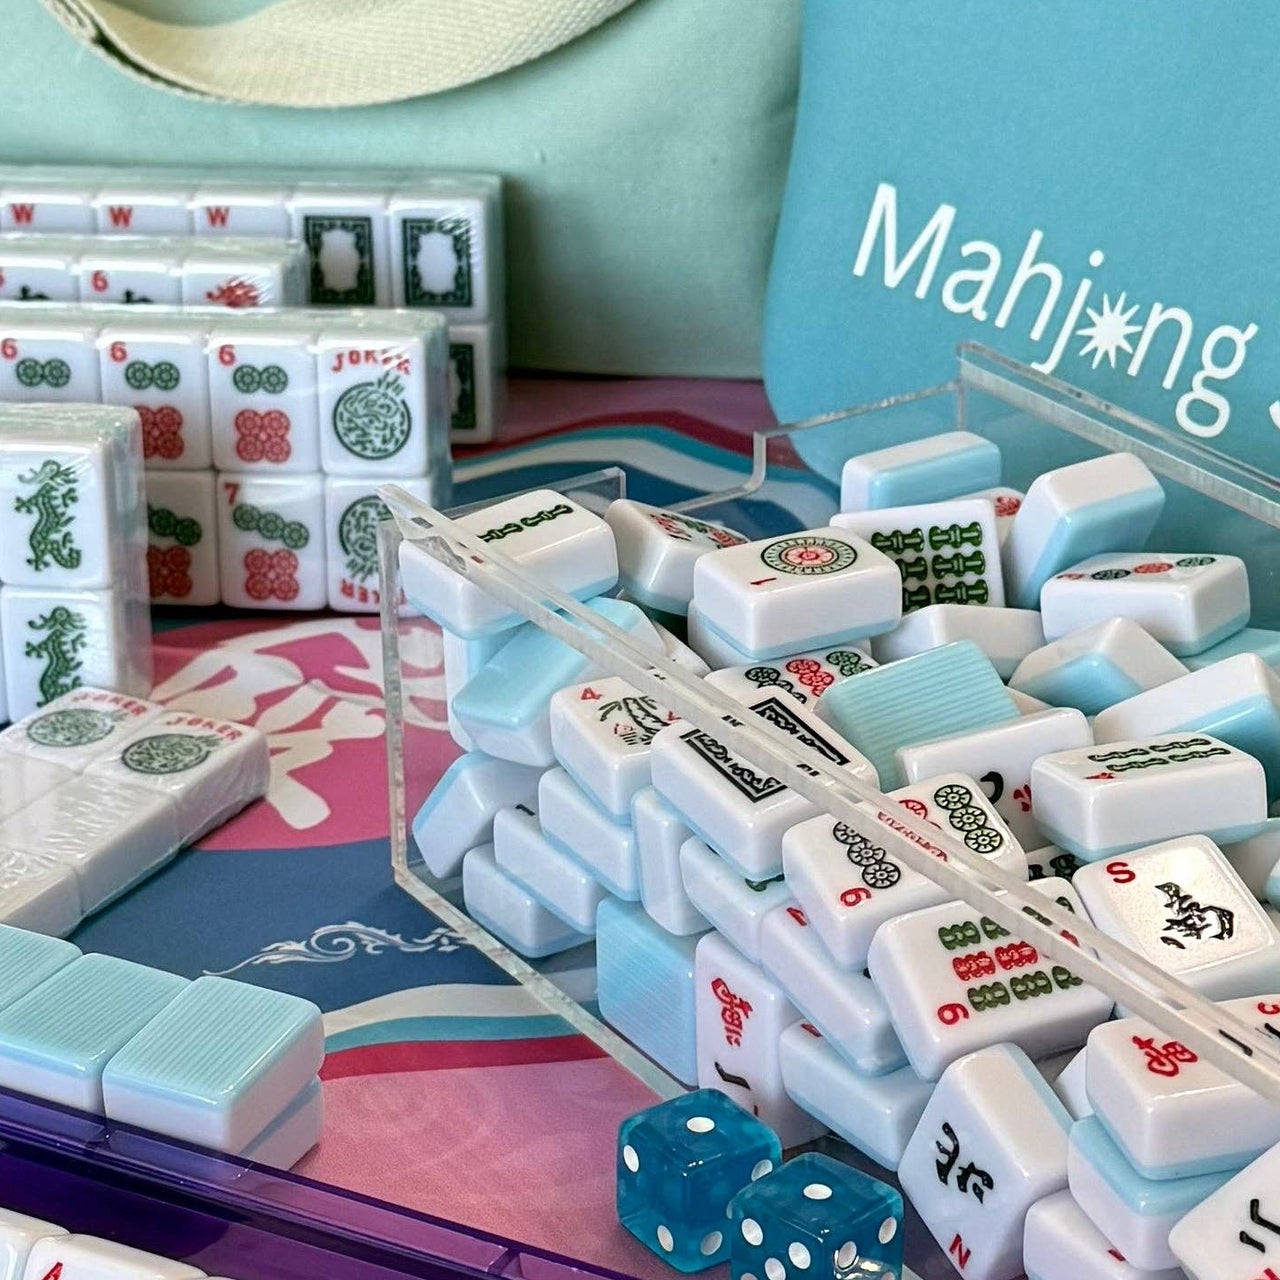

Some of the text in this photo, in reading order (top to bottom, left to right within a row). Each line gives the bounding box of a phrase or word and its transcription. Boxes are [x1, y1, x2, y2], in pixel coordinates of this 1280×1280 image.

[12, 204, 34, 224] W
[110, 208, 133, 227] W
[207, 208, 229, 225] W
[90, 271, 108, 292] 6
[0, 340, 18, 360] 6
[108, 341, 128, 363] 6
[217, 345, 236, 367] 6
[219, 479, 242, 507] 7
[166, 715, 243, 741] JOKER
[1105, 860, 1137, 885] S
